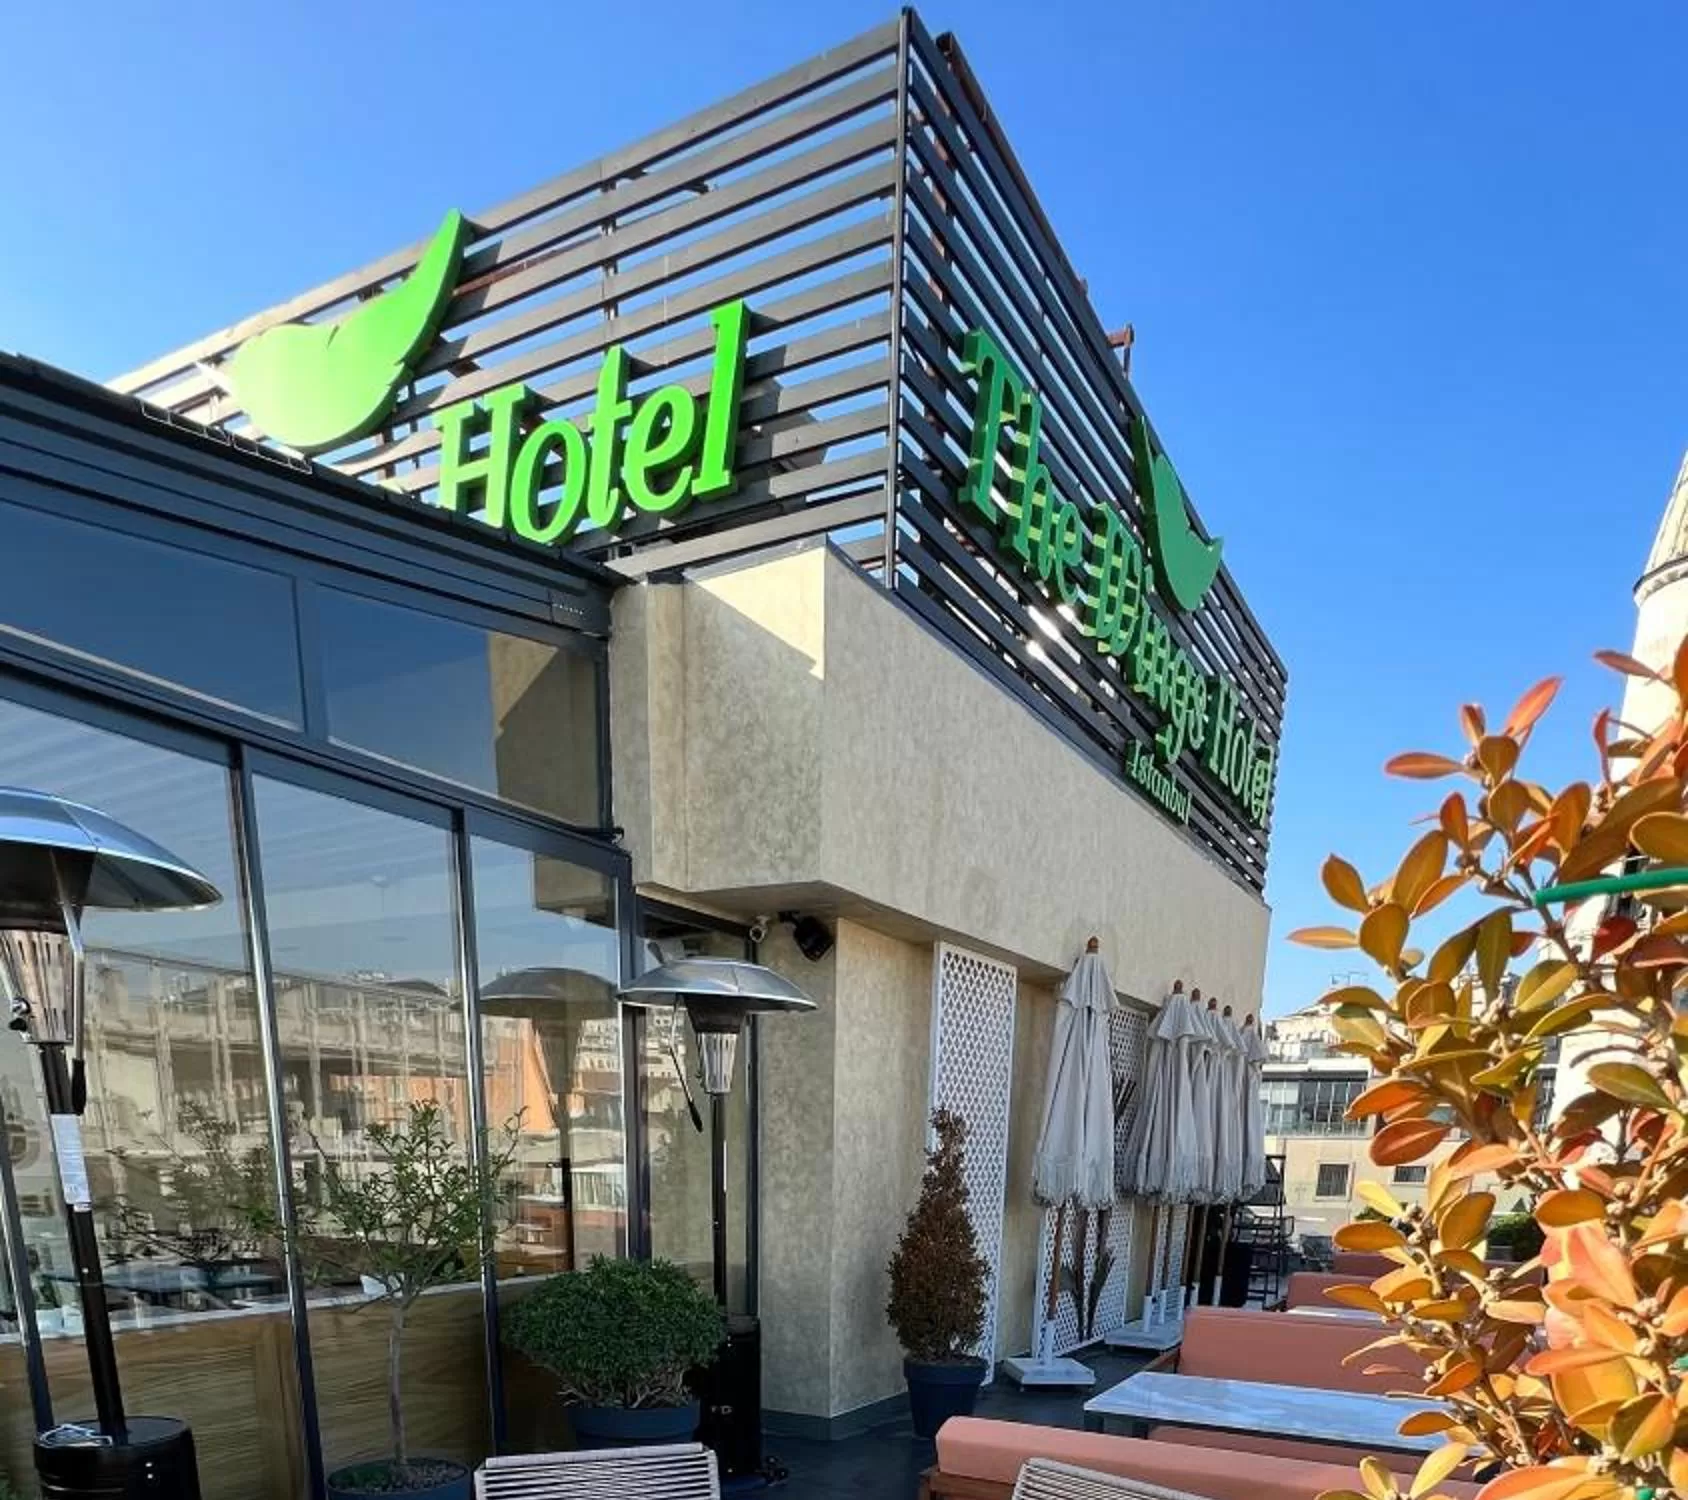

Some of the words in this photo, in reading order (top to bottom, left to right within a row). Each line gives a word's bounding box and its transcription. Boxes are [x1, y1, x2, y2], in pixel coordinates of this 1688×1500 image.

[433, 299, 748, 545] Hotel
[960, 327, 1083, 607] The
[1208, 672, 1274, 829] Hotel
[1127, 738, 1193, 826] Istanbul
